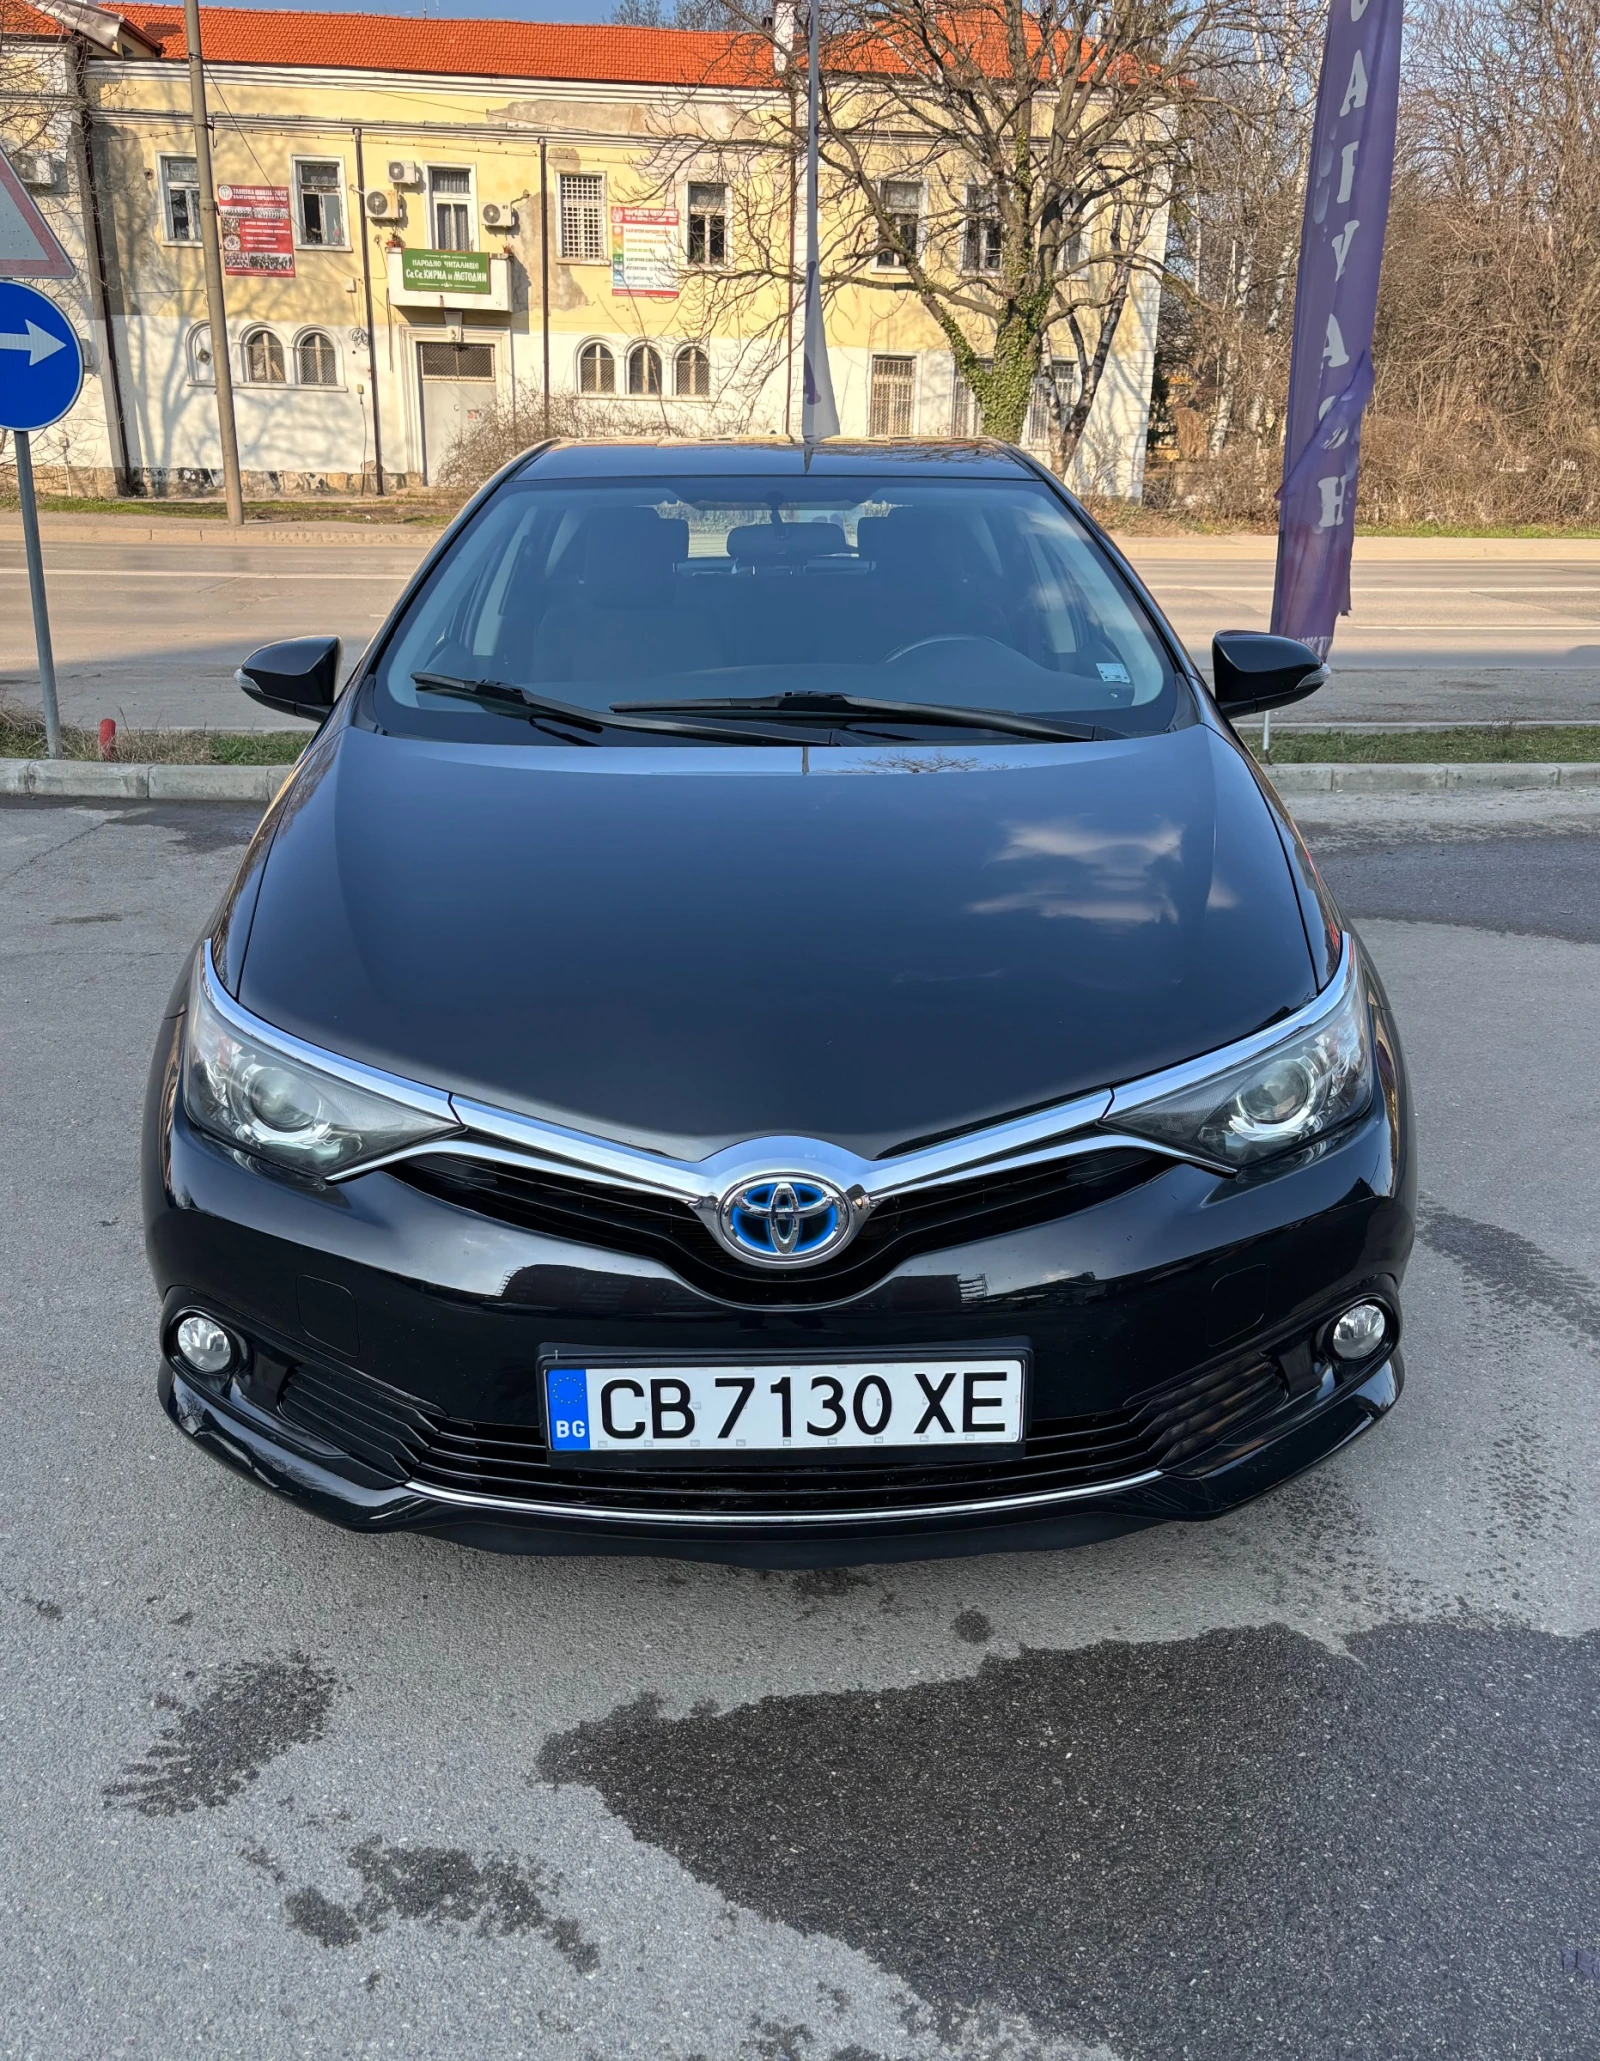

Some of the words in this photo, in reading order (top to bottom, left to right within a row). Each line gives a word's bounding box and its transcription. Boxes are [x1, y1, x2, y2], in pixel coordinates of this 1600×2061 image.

[412, 259, 442, 268] НАРОДНО
[444, 260, 479, 270] ЧИТАЛИЩЕ
[601, 1378, 695, 1439] CB
[714, 1374, 892, 1439] 7130
[913, 1371, 1008, 1435] XE
[556, 1420, 585, 1438] BG
